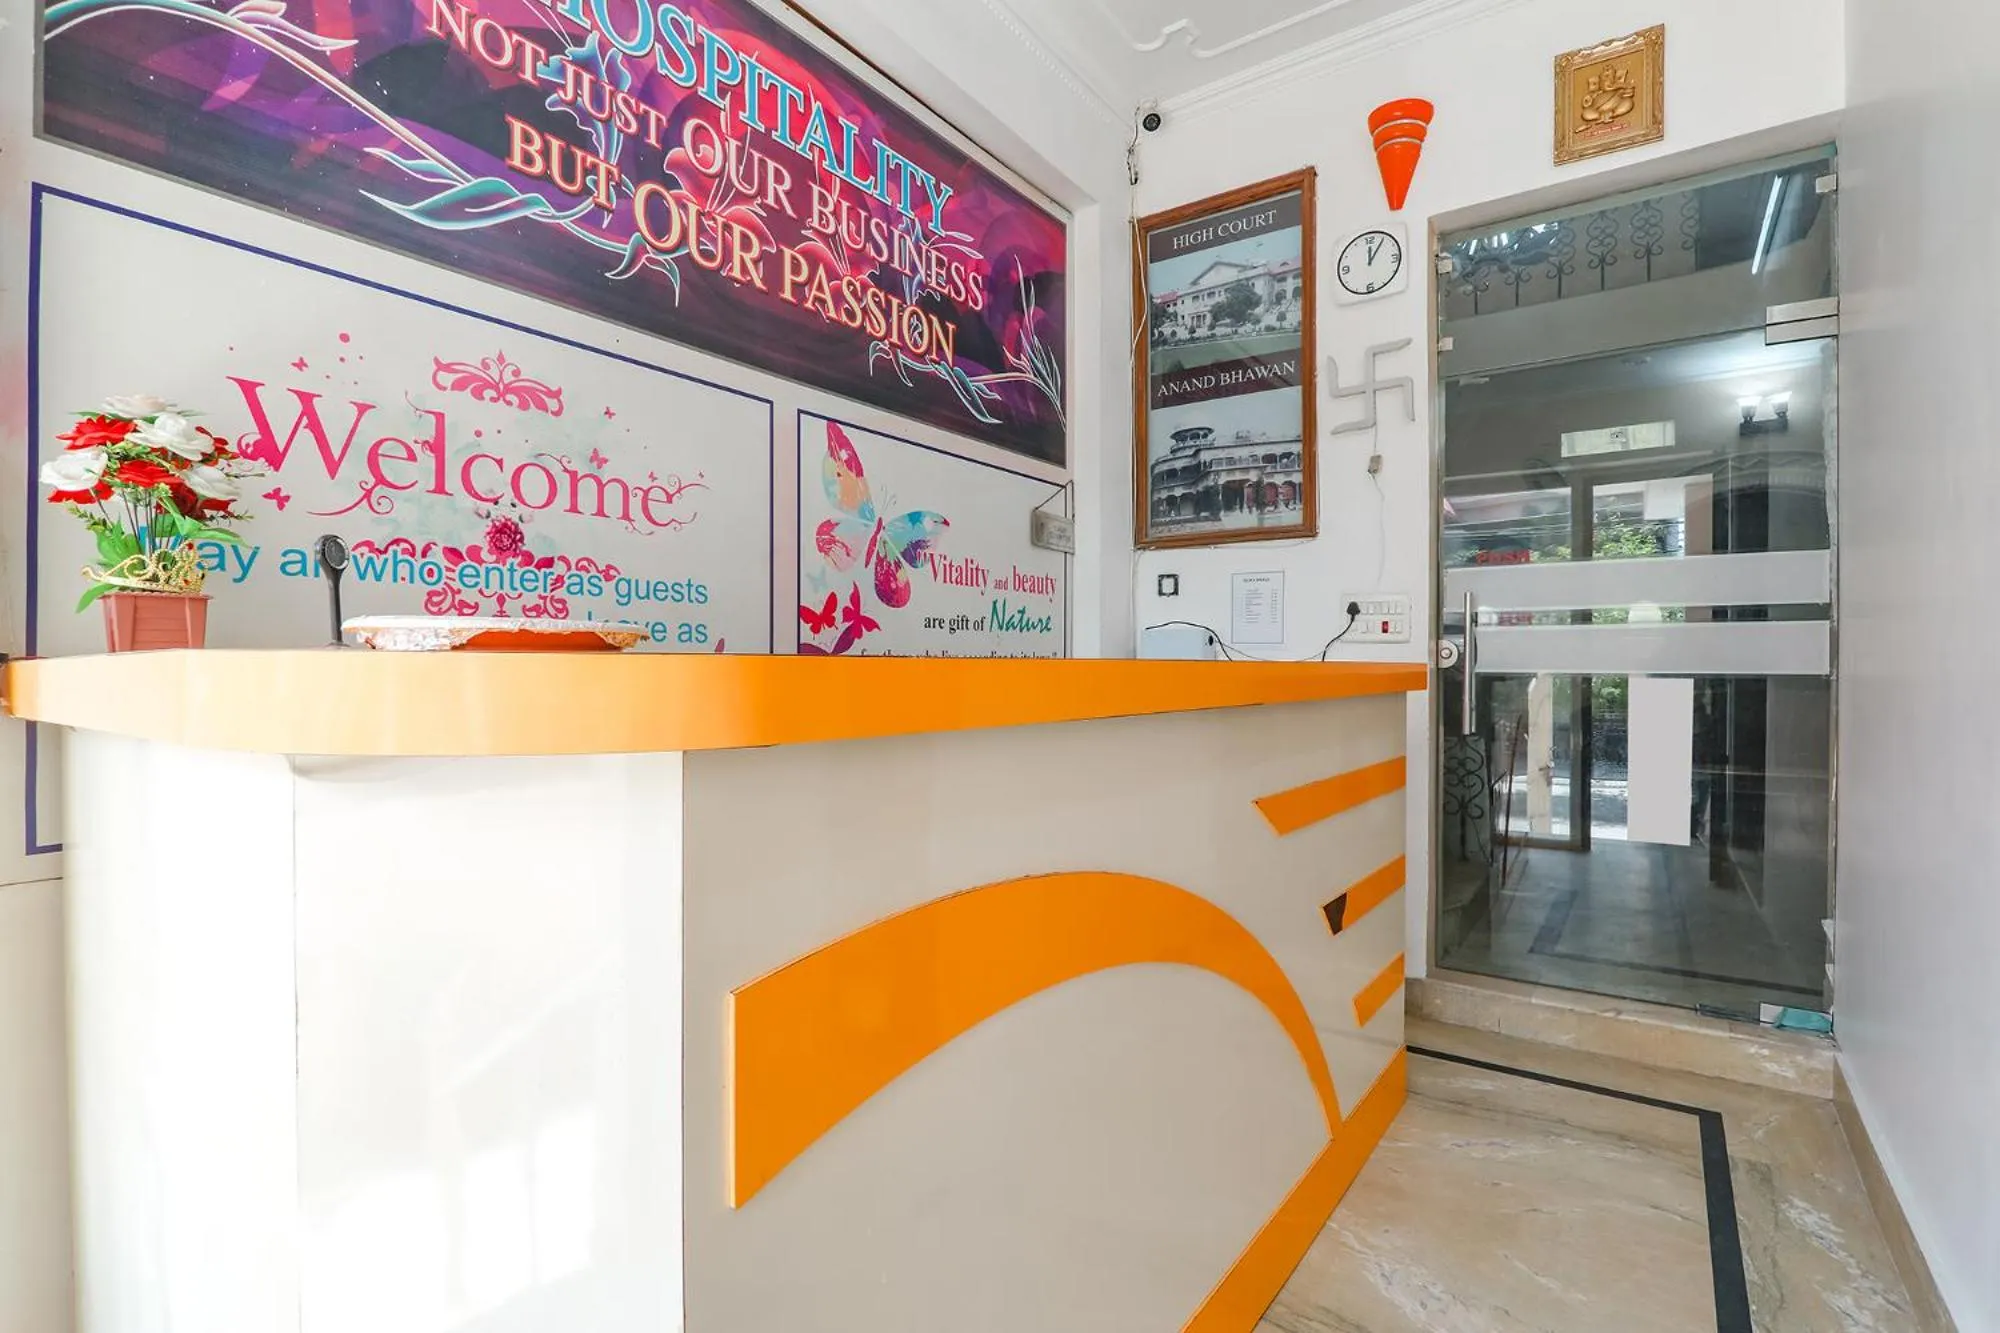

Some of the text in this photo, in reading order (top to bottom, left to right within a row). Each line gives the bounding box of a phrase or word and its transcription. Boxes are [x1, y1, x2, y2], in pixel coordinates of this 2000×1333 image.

[536, 0, 955, 236] OSPITALITY
[426, 0, 985, 312] NOT JUST OUR BUSINESS
[504, 114, 957, 367] BUT OUR PASSION
[1172, 209, 1278, 250] HIGH COURT
[1364, 236, 1376, 246] 12
[1341, 265, 1351, 276] 9
[1391, 253, 1400, 264] 3
[1365, 282, 1376, 294] 6
[1157, 360, 1296, 397] ANAND BHAWAN
[226, 376, 700, 532] Welcome
[351, 547, 443, 587] who
[458, 560, 561, 596] enter
[566, 565, 603, 597] as
[615, 573, 709, 607] guests
[993, 577, 1008, 591] and
[1012, 564, 1057, 603] beauty
[677, 621, 708, 644] as
[924, 598, 1053, 634] are gift of Nature
